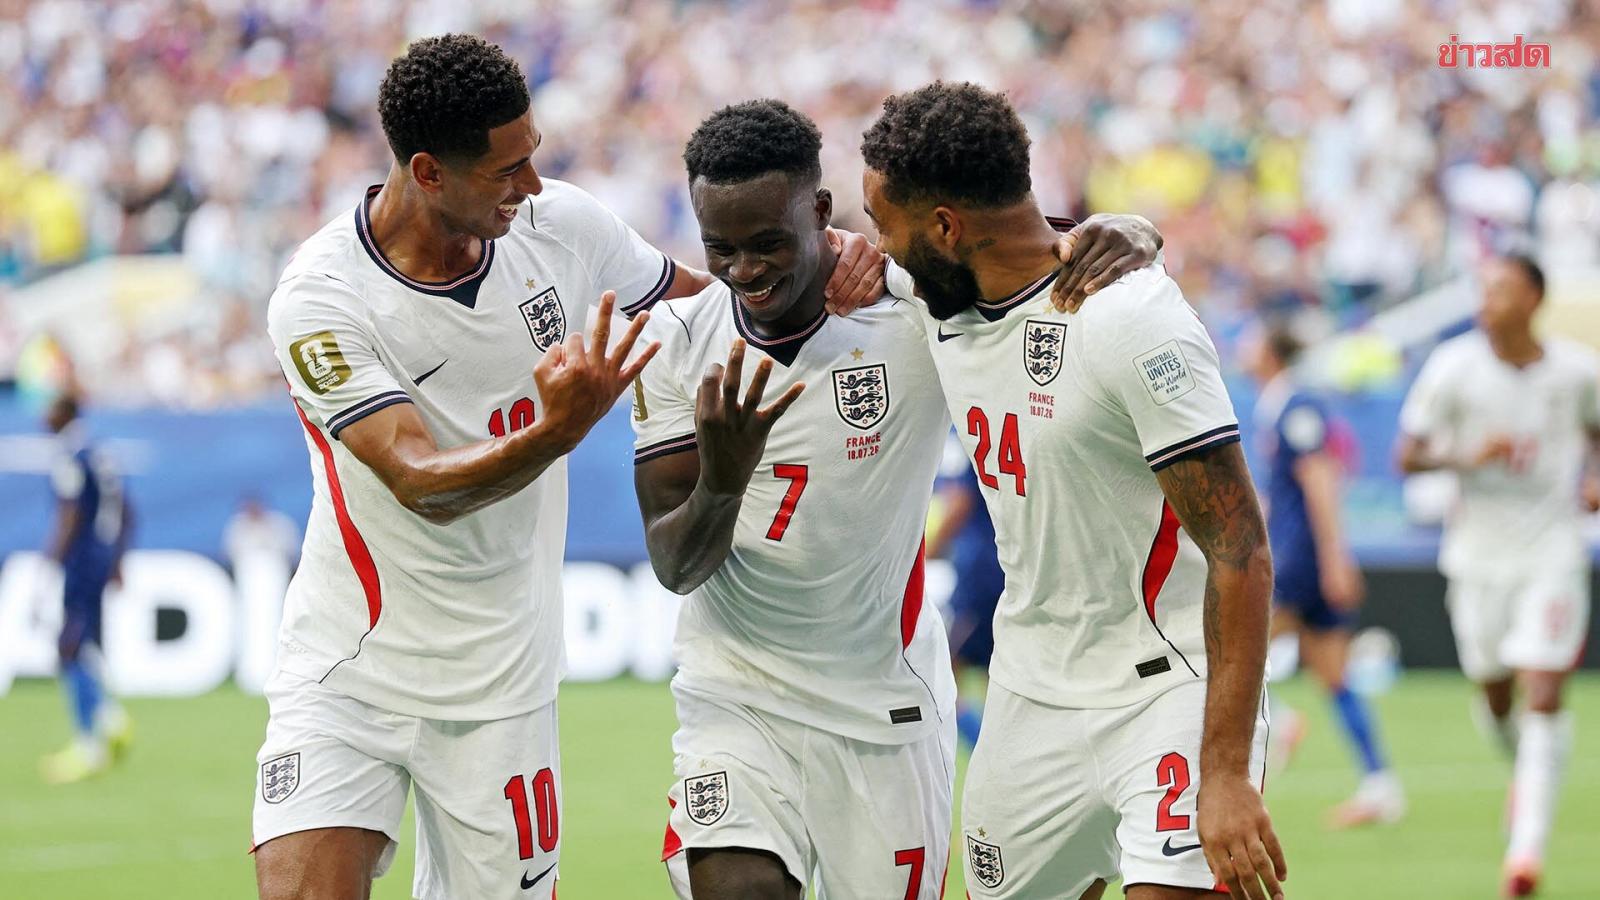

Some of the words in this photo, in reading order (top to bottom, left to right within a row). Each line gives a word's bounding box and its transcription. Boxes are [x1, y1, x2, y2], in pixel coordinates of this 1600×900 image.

[1142, 349, 1176, 370] FOOTBALL
[1146, 357, 1181, 381] UNITES
[1029, 391, 1055, 406] FRANCE
[846, 432, 881, 448] FRANCE
[847, 445, 880, 460] 18.07.26
[967, 406, 1026, 497] 24
[765, 463, 809, 541] 7
[1156, 751, 1199, 832] 2
[504, 767, 559, 860] 10
[894, 846, 925, 900] 7
